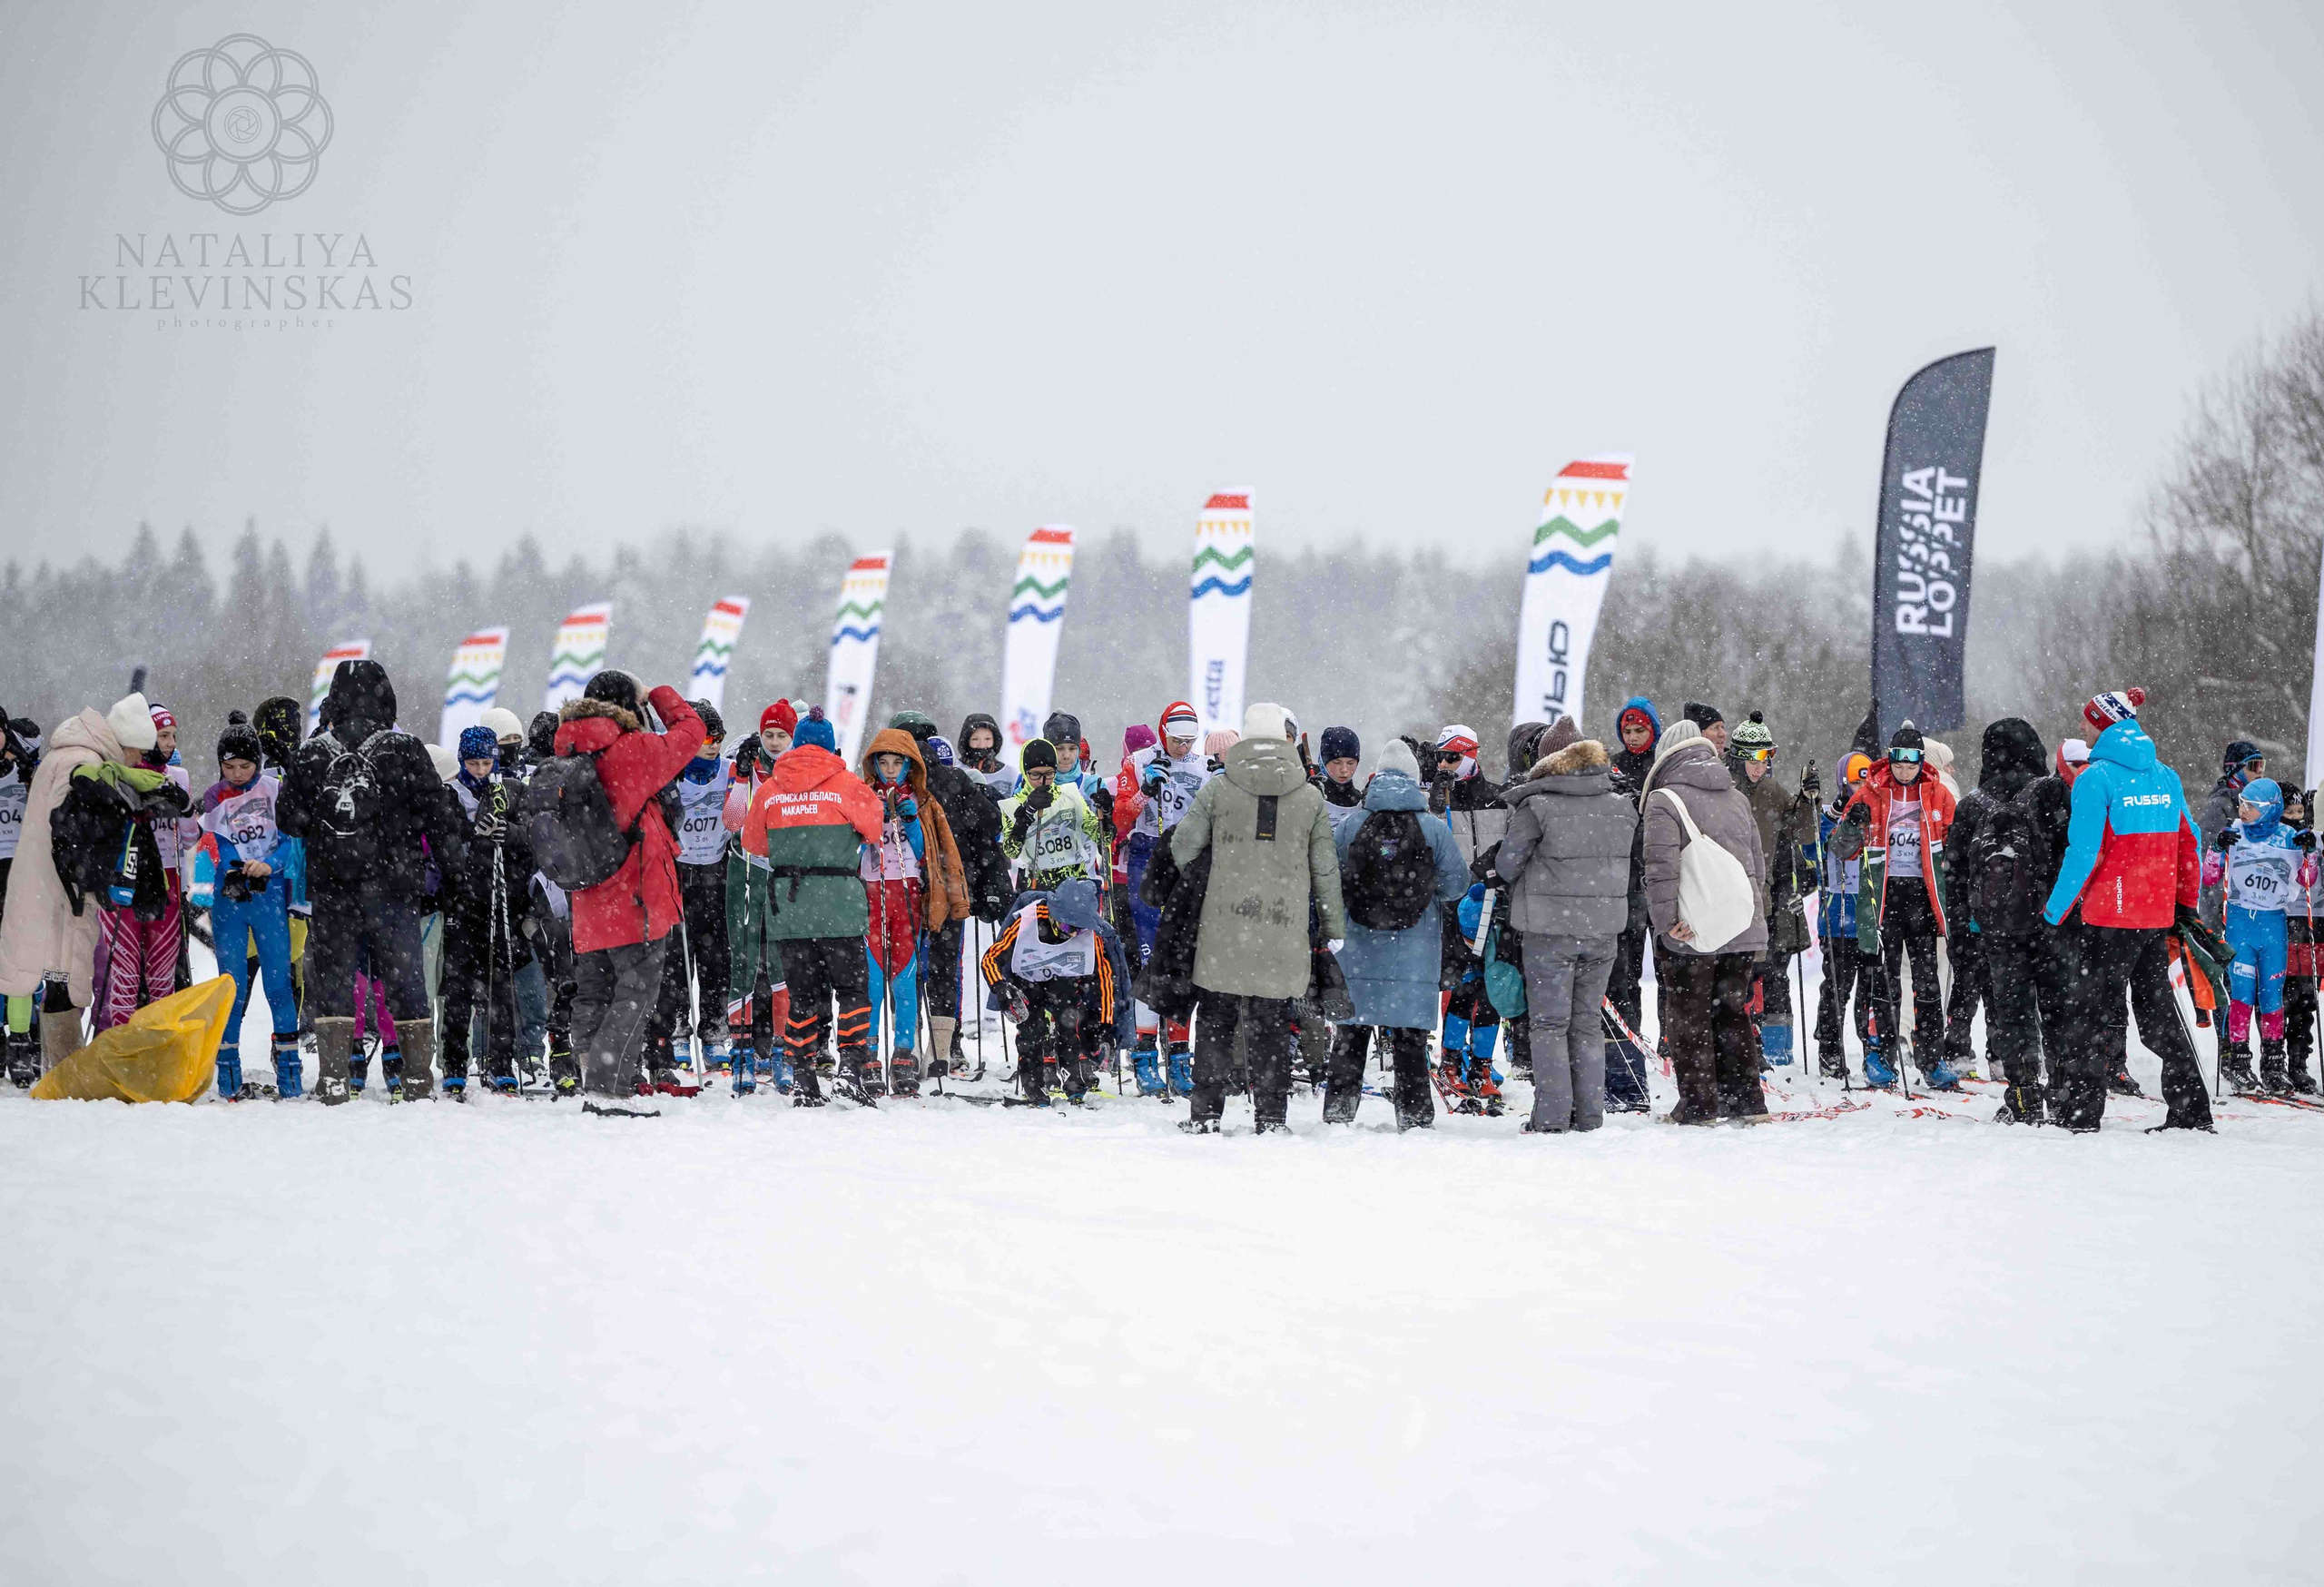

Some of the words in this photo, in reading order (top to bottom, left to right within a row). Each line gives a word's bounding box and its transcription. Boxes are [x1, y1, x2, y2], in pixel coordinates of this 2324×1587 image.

[1896, 467, 1935, 636] RUSSIA
[809, 792, 843, 804] ОБЛАСТЬ
[2122, 794, 2171, 808] RUSSIA
[782, 803, 818, 817] МАКАРЬЕВ
[684, 816, 718, 833] 6077
[230, 825, 266, 845] 6082
[1038, 835, 1072, 855] 6088
[2244, 873, 2279, 894] 6101
